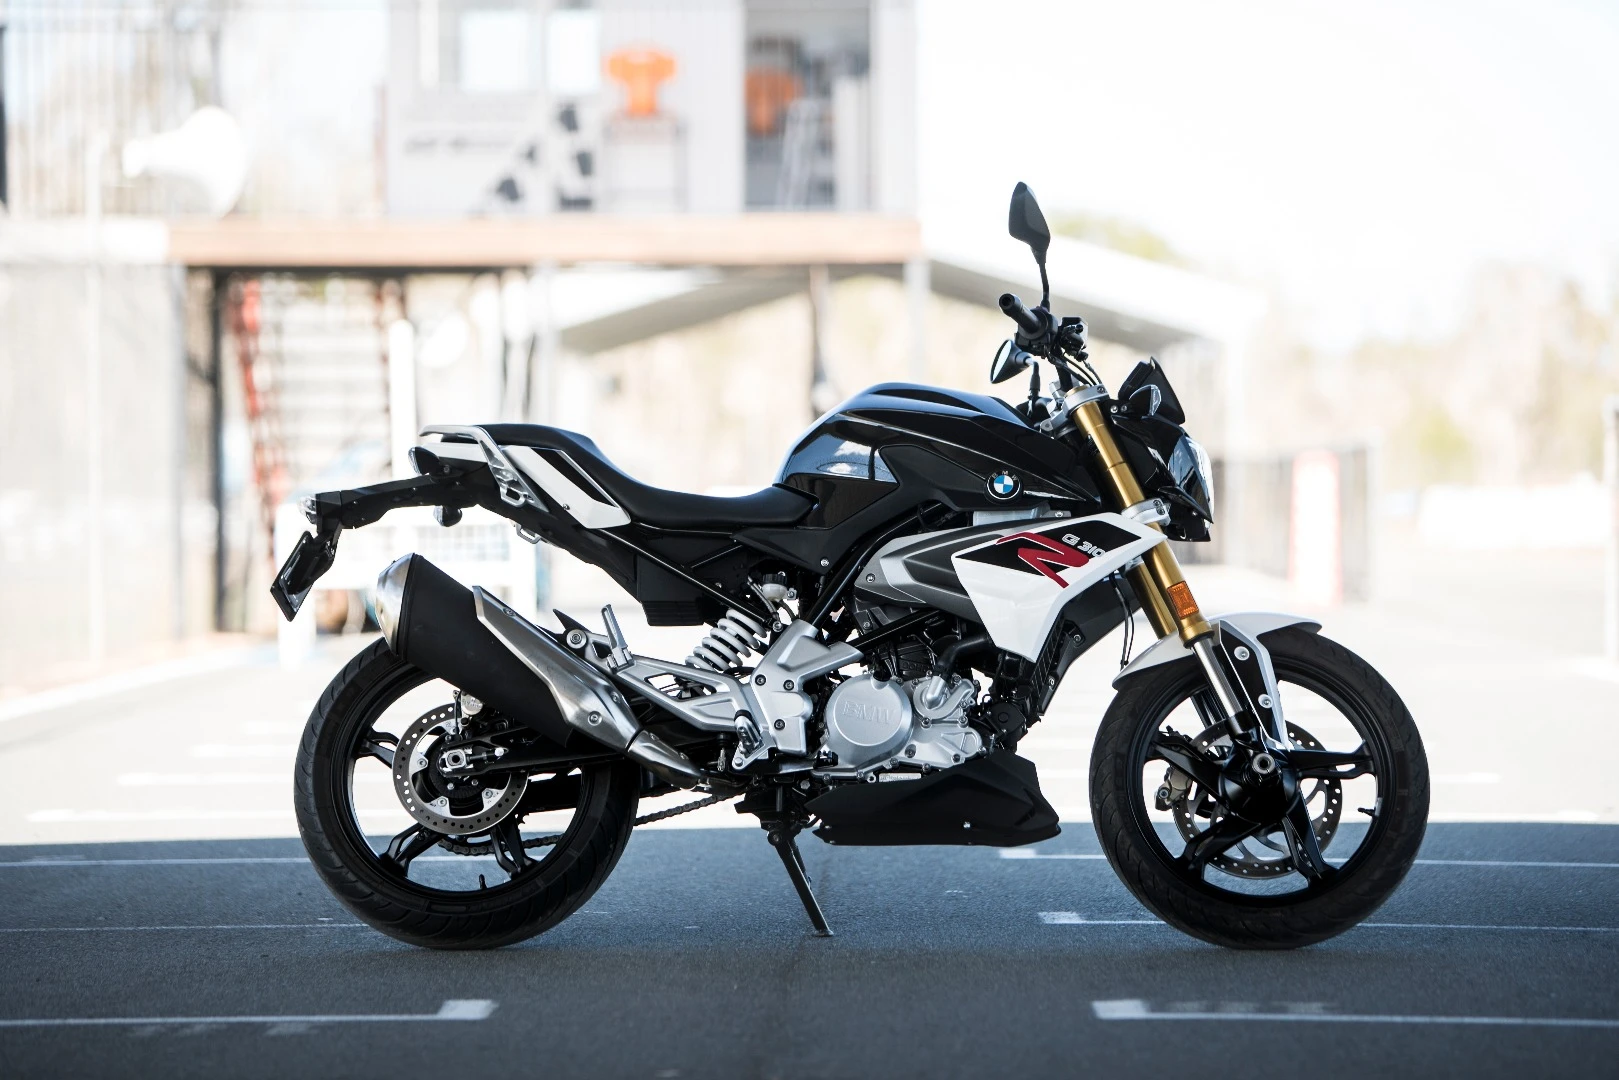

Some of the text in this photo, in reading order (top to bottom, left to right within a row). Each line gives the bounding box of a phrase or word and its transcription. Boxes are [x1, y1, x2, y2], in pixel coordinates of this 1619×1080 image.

[1061, 533, 1106, 557] G 310
[842, 700, 896, 725] BMW
